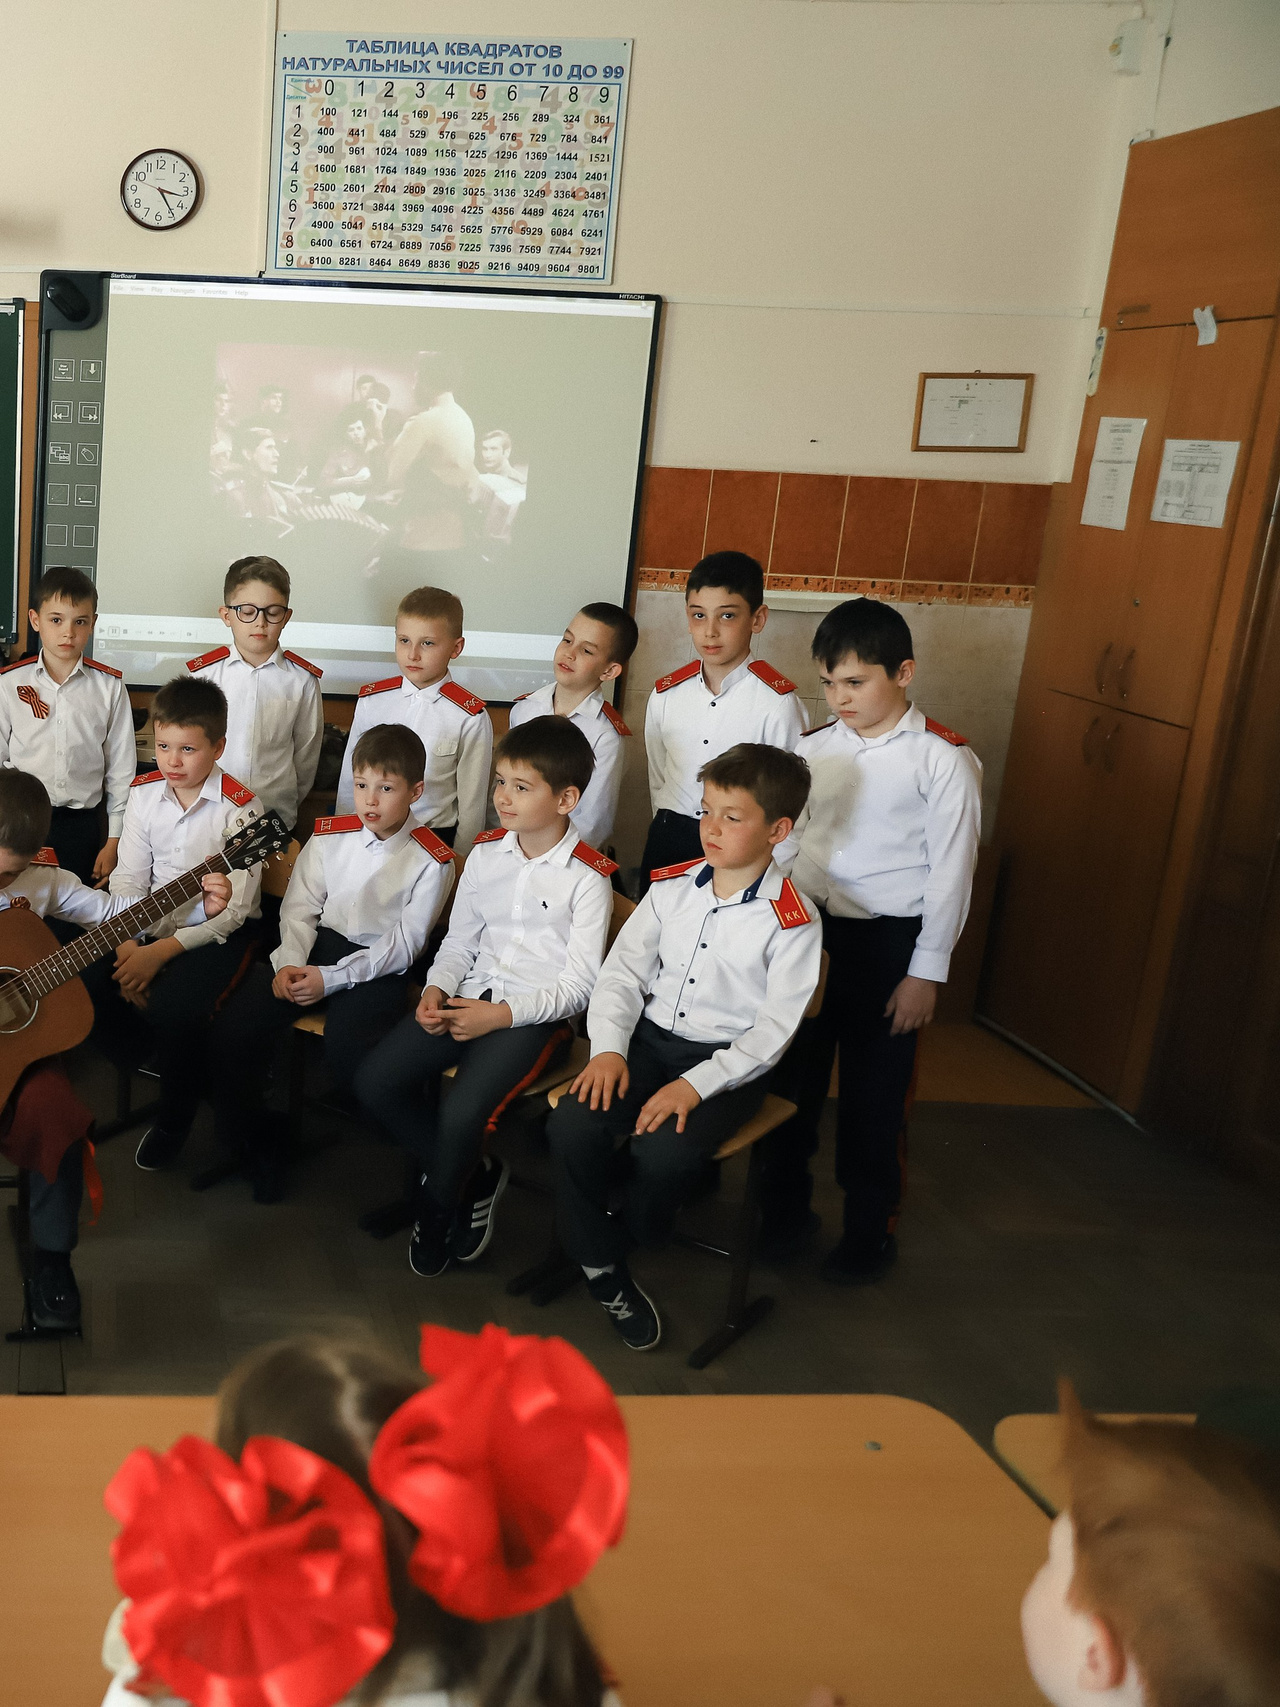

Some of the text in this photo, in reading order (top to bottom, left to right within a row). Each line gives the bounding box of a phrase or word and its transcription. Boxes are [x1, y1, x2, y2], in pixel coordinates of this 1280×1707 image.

[345, 39, 562, 59] ТАБЛИЦА КВАДРАТОВ
[281, 57, 624, 80] НАТУРАЛЬНЫХ ЧИСЕЛ ОТ 10 ДО 99
[324, 79, 610, 104] 0 1 2 3 4 5 6 7 8 9
[295, 104, 611, 125] 1 100 121 144 169 196 225 256 289 324 361
[292, 123, 608, 144] 2 400 441 484 529 576 625 676 729 784 841
[292, 141, 610, 163] 3 900 961 1024 1089 1156 1225 1296 1369 1444 1521
[146, 162, 153, 173] 11
[156, 159, 167, 170] 12
[290, 160, 608, 182] 4 1600 1681 1764 1849 1936 2025 2116 2209 2304 2401
[135, 171, 147, 182] 10
[178, 172, 186, 183] 2
[130, 184, 138, 195] 9
[182, 186, 189, 197] 3
[289, 179, 606, 200] 5 2500 2601 2704 2809 2916 3025 3136 3249 3364 3481
[133, 198, 142, 209] 8
[143, 207, 150, 218] 7
[176, 199, 184, 210] 4
[288, 198, 605, 219] 6 3600 3721 3844 3969 4096 4225 4356 4489 4624 4761
[154, 211, 163, 222] 6
[288, 216, 603, 238] 7 4900 5041 5184 5329 5476 5625 5776 5929 6084 6241
[285, 234, 602, 256] 8 6400 6561 6724 6889 7056 7225 7396 7569 7744 7921
[285, 253, 600, 274] 9 8100 8281 8464 8649 8836 9025 9216 9409 9604 9801
[110, 272, 137, 280] StarBoard
